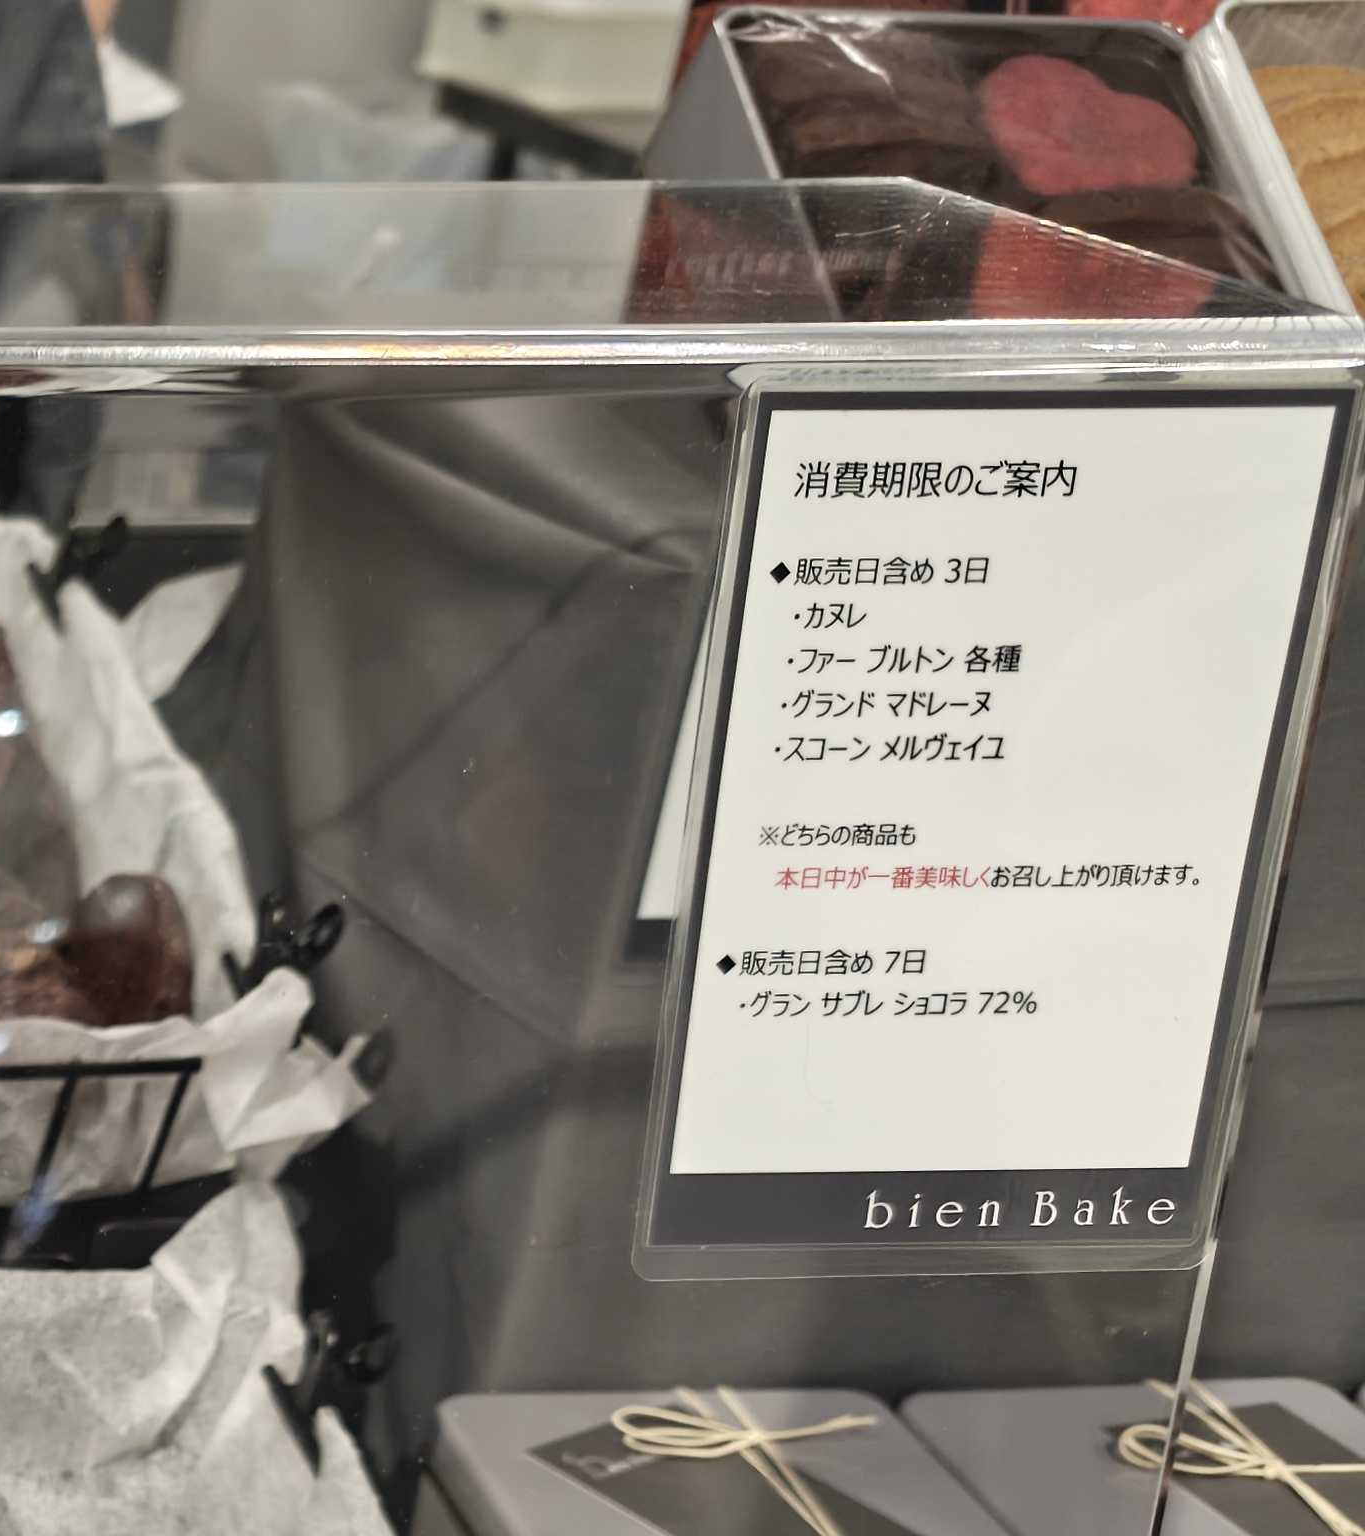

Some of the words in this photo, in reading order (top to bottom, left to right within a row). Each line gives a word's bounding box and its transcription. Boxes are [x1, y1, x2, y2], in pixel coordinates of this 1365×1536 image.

[794, 459, 1078, 499] 消費期限のご案内
[944, 557, 990, 585] 3日
[866, 644, 955, 674] ブルトン
[964, 644, 1022, 674] 各種
[886, 690, 992, 718] マドレーヌ
[879, 732, 1005, 762] メルヴェイユ
[885, 949, 926, 975] 7日
[821, 989, 884, 1017] サブレ
[893, 991, 968, 1016] ショコラ
[978, 990, 1038, 1015] 72%
[863, 1190, 1000, 1229] bien
[1029, 1186, 1176, 1227] Bake
